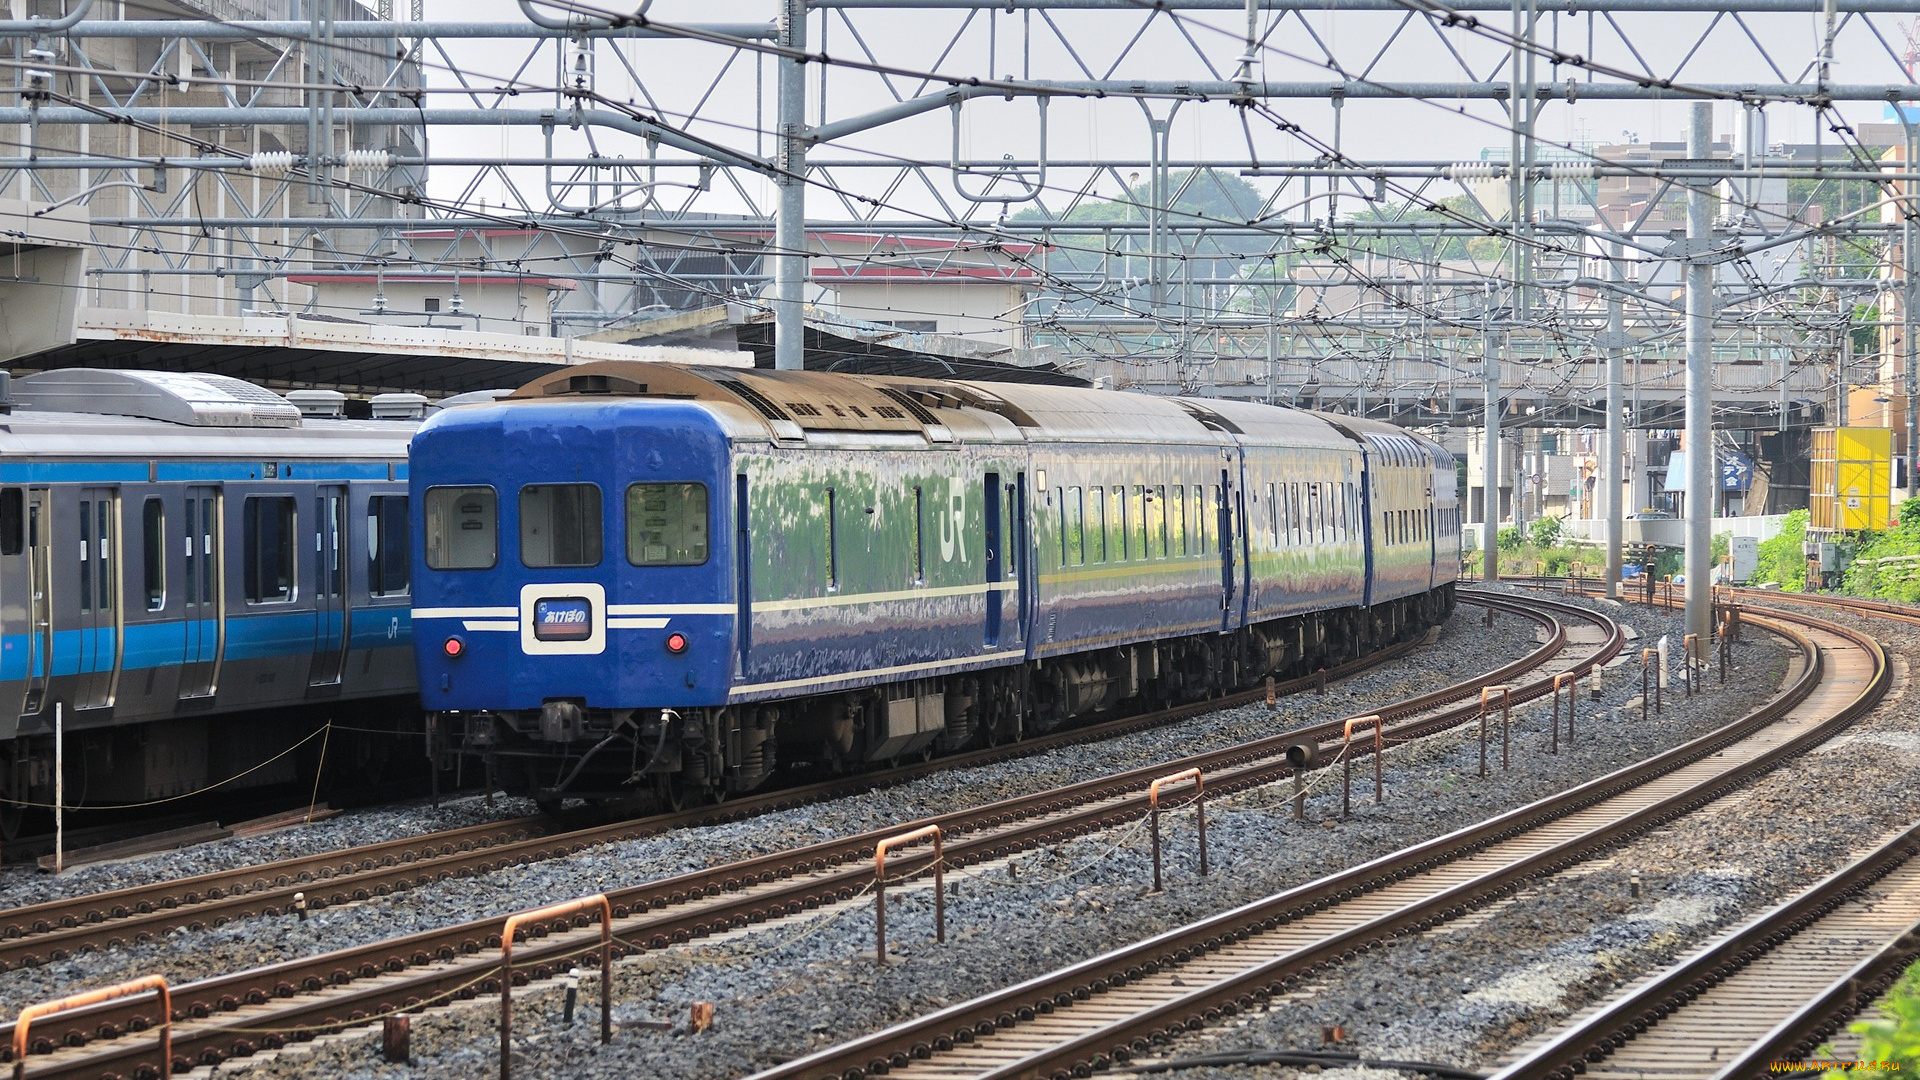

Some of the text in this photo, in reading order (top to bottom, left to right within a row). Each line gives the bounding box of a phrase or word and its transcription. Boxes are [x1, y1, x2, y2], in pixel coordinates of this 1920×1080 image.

[940, 476, 967, 563] JR
[544, 608, 586, 623] あけぼの
[387, 616, 398, 640] JR
